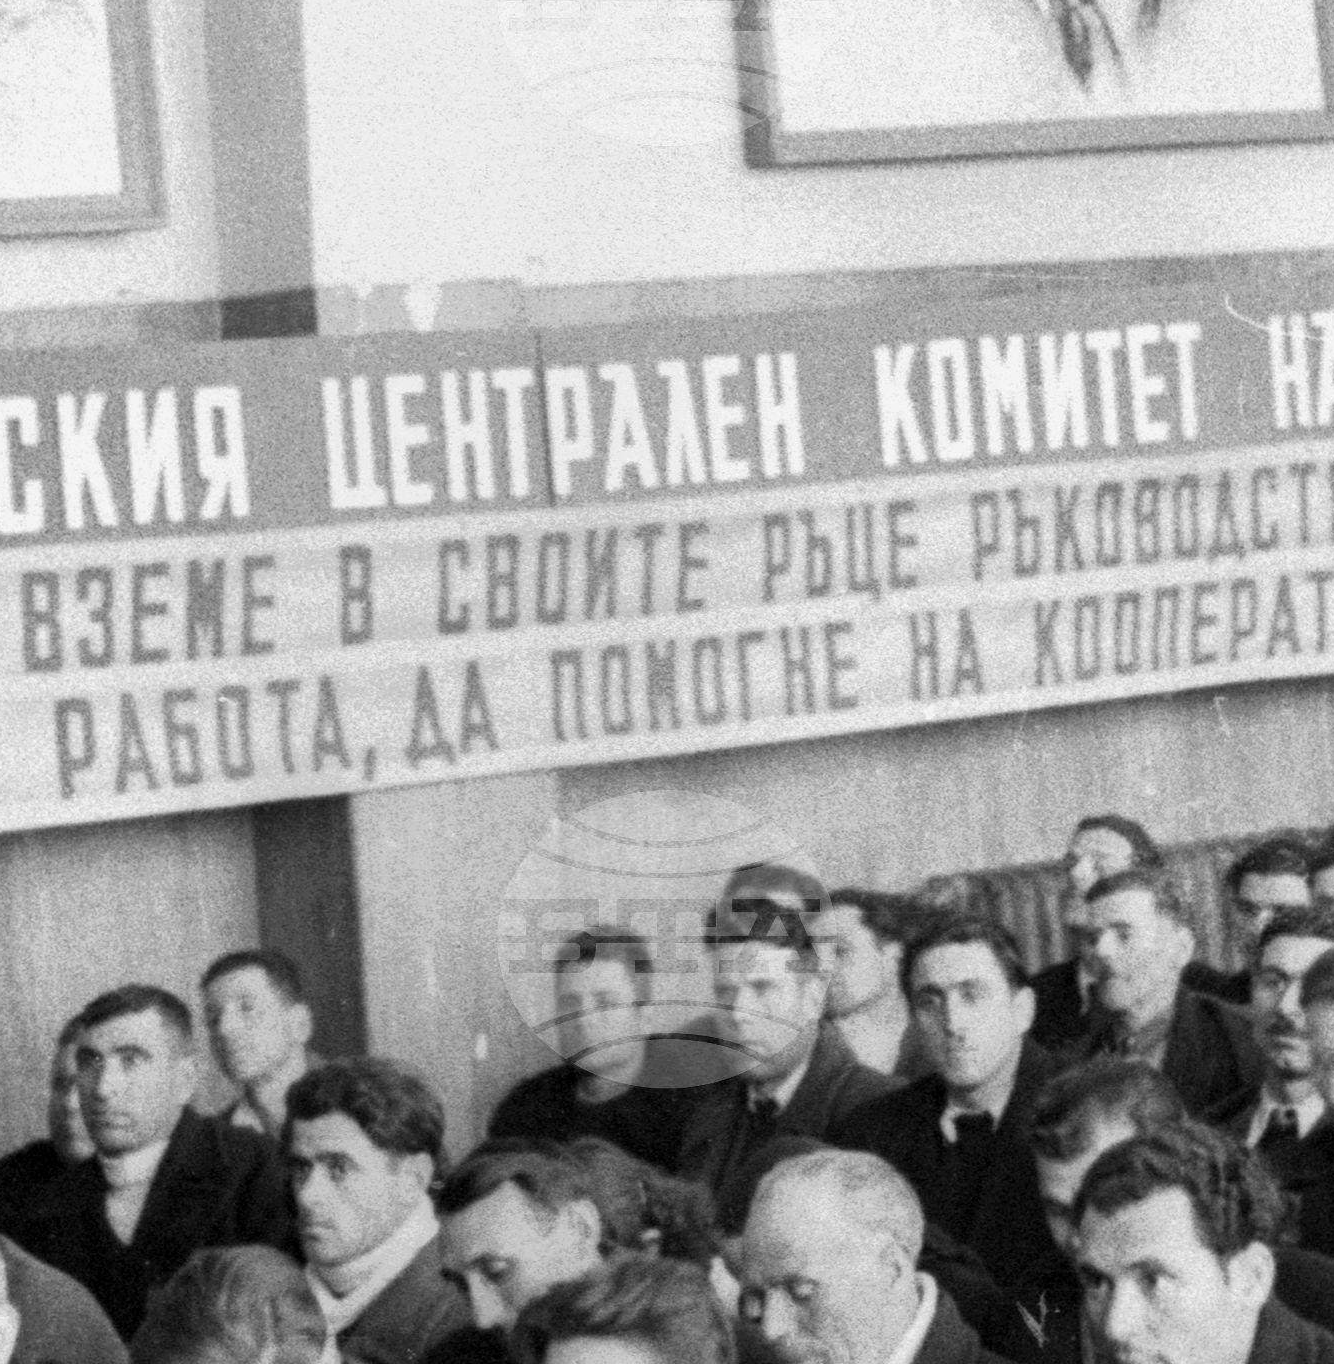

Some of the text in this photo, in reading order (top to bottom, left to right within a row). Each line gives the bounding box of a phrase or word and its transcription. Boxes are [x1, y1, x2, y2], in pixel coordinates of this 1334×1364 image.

[322, 352, 806, 510] ЦЕНТРАЛЕН
[873, 321, 1201, 467] КОМИТЕТ
[20, 554, 276, 674] ВЗЕМЕ
[339, 542, 375, 646] В
[437, 520, 710, 636] СВОИТЕ
[761, 500, 920, 603] РЪЦЕ
[403, 660, 499, 770] ДА
[550, 621, 859, 742] ПОМОГНЕ
[909, 609, 986, 701] НА
